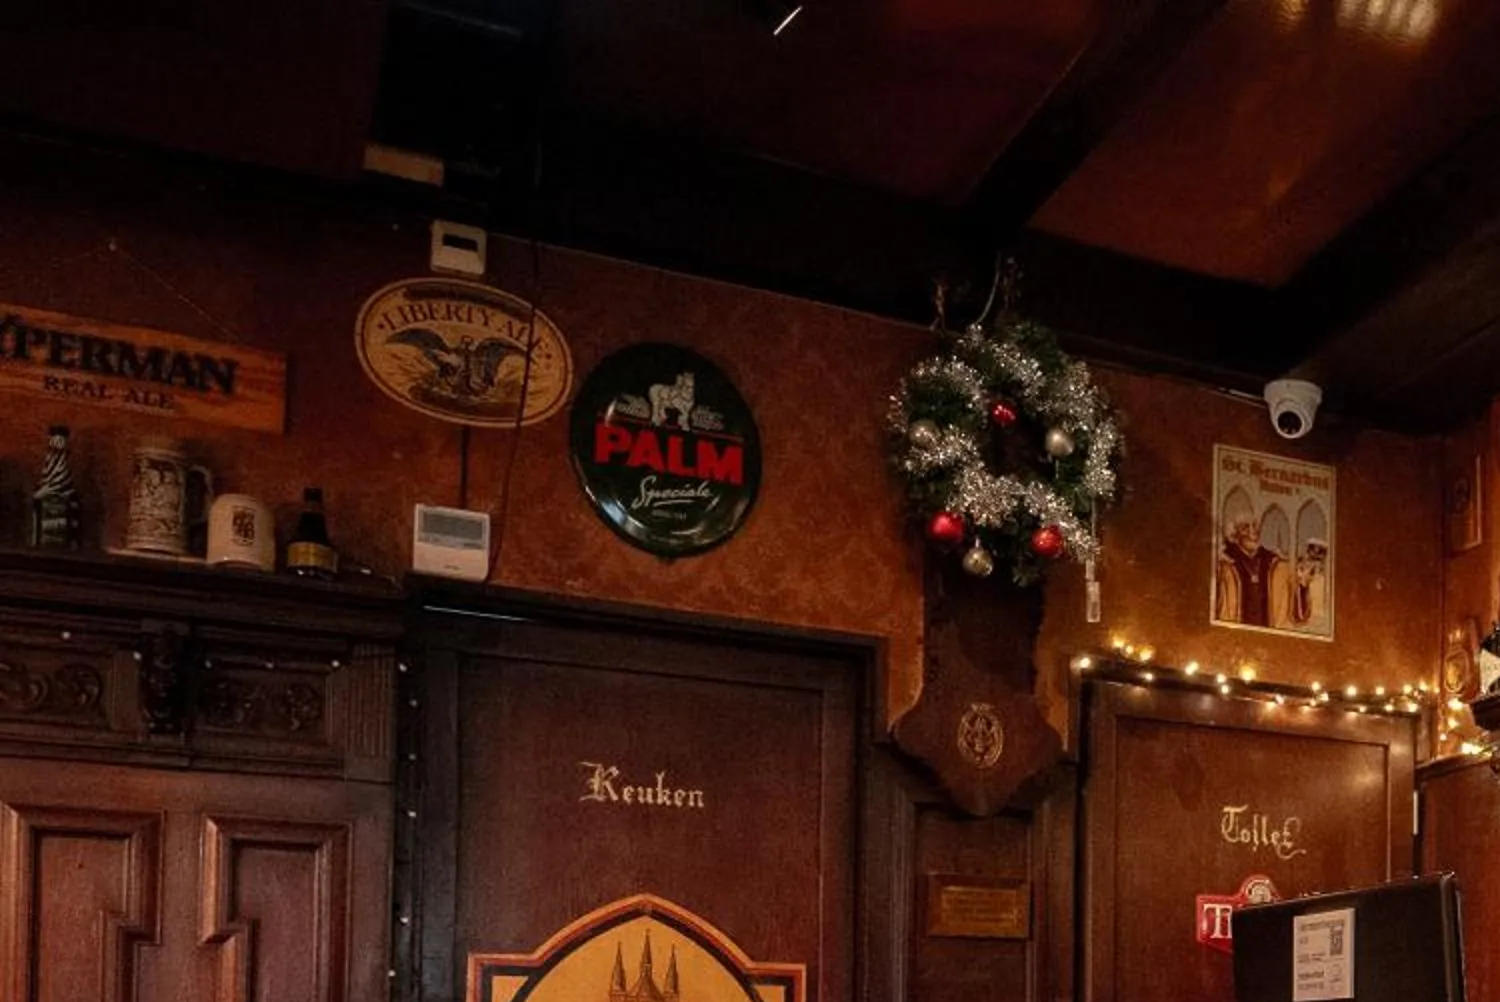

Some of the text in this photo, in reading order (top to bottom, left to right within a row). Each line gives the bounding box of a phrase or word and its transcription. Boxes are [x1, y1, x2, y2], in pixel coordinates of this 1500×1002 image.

[382, 302, 496, 331] LIBERTY
[44, 375, 175, 409] REAL ALE
[594, 421, 744, 486] PALM
[578, 761, 705, 808] Keuken
[1221, 804, 1307, 860] Toilet
